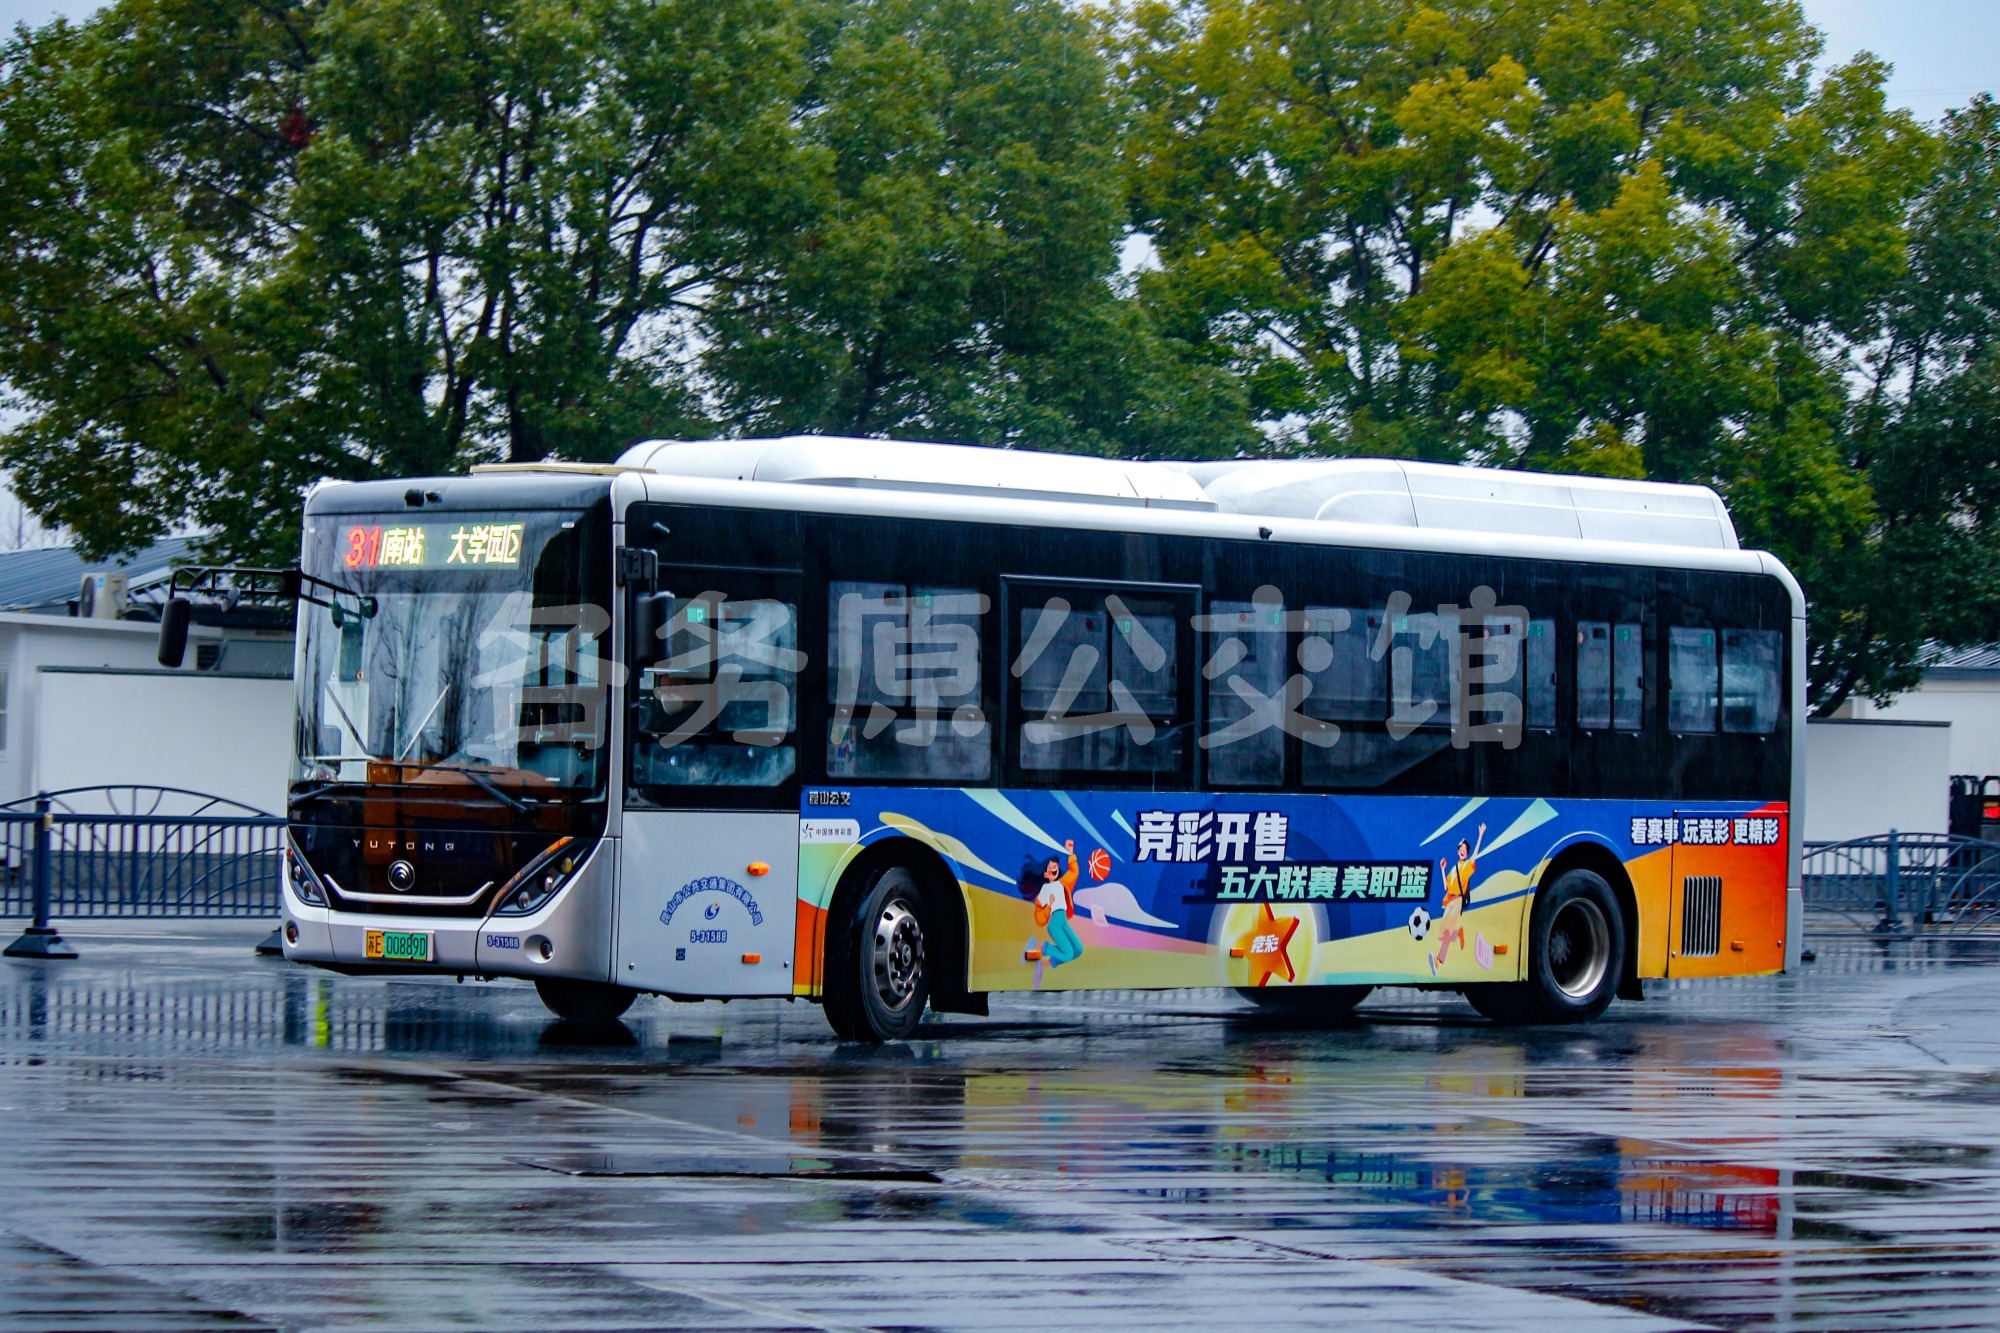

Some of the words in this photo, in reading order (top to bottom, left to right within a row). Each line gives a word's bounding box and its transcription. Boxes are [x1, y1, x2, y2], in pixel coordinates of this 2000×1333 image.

[344, 525, 382, 569] 31
[808, 790, 851, 806] 昆山公交
[1137, 810, 1289, 862] 竞彩开售
[1631, 818, 1679, 845] 看赛事
[1681, 818, 1730, 845] 玩竞彩
[1733, 818, 1780, 845] 更精彩
[353, 839, 455, 851] YUTONG
[1216, 866, 1339, 899] 五大联赛
[1340, 866, 1429, 899] 美职篮
[486, 934, 520, 949] 5-31588
[690, 930, 728, 943] 5-31588
[1250, 934, 1280, 954] 竞彩
